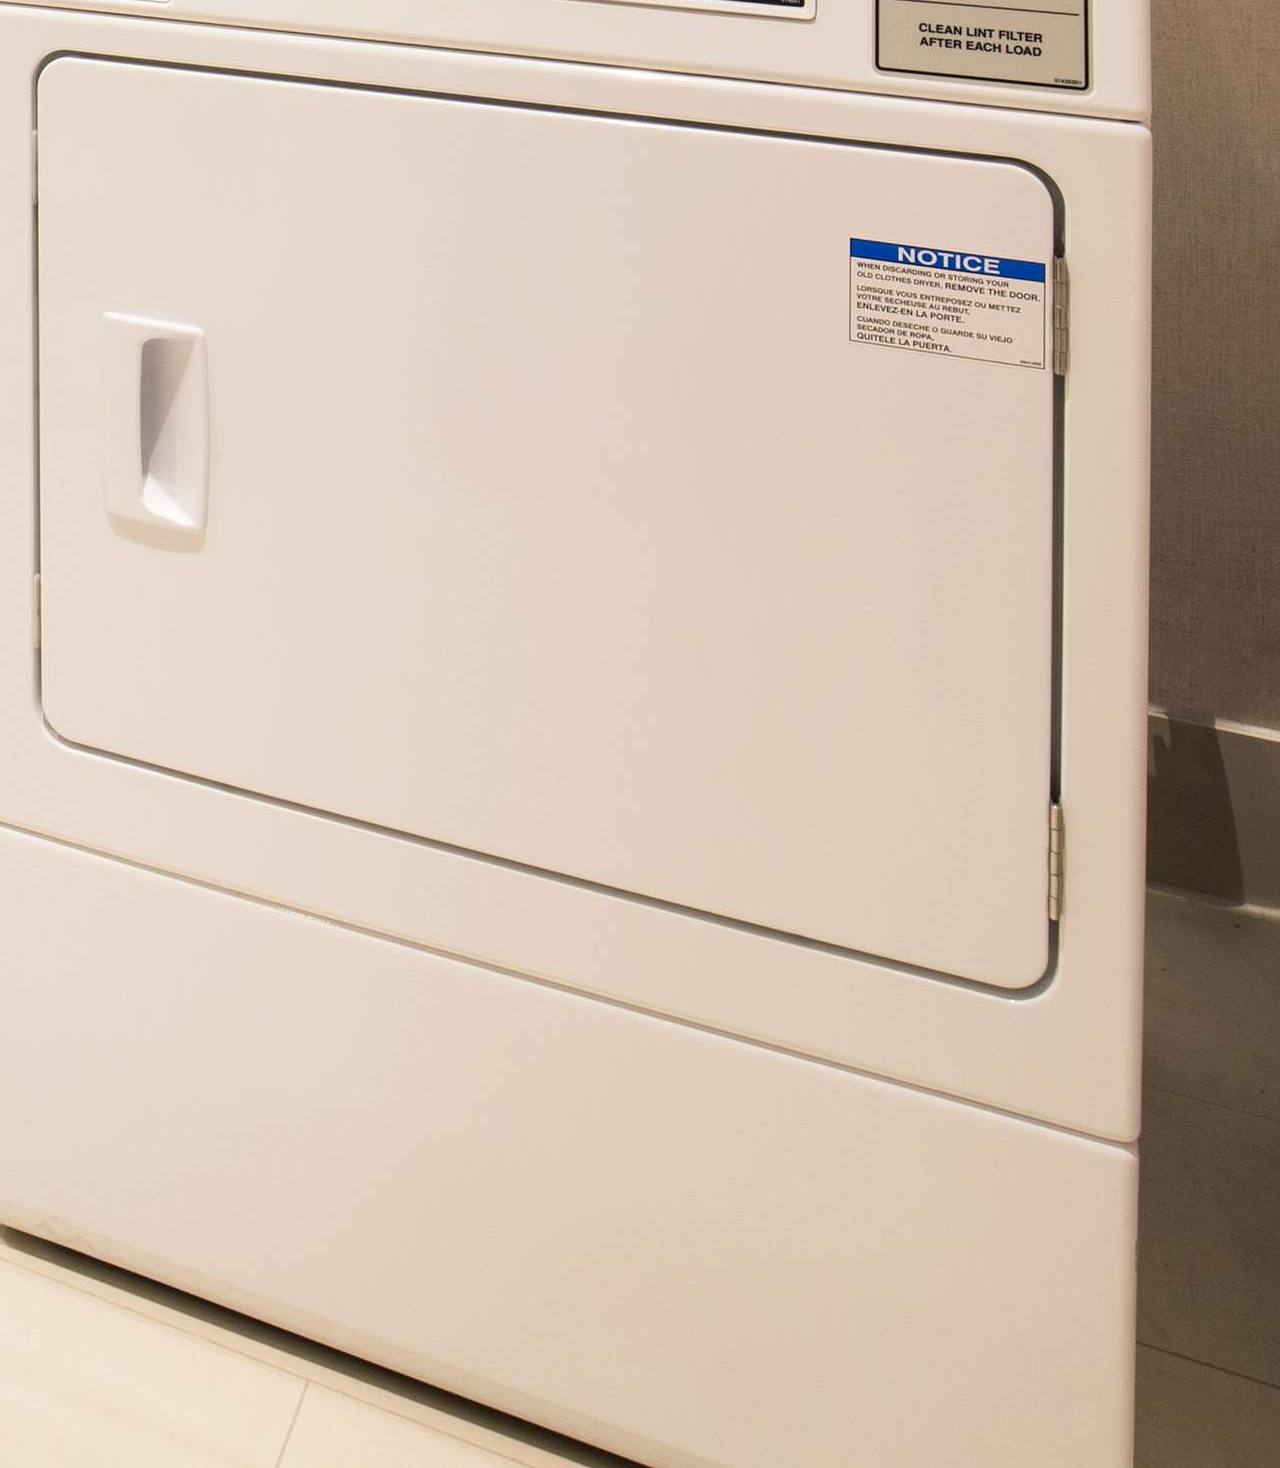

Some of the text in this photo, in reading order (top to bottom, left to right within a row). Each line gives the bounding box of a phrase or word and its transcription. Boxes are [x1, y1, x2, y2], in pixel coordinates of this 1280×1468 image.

[919, 23, 1043, 43] CLEAN LINT FILTER
[920, 38, 1042, 57] AFTER EACH LOAD
[898, 248, 1000, 273] NOTICE
[857, 262, 881, 271] WHEN
[882, 265, 932, 277] DISCARDING
[947, 273, 984, 284] STORING
[985, 278, 1009, 287] YOUR
[874, 274, 911, 284] CLOTHES
[913, 279, 943, 290] DRYER,
[945, 284, 985, 295] REMOVE
[987, 288, 1007, 297] THE
[1009, 291, 1040, 301] DOOR.
[857, 285, 894, 296] LORSQUE
[895, 290, 918, 299] VOUS
[919, 294, 973, 306] ENTREPOSEZ
[988, 303, 1021, 313] METTEZ
[857, 294, 882, 303] VOTRE
[884, 297, 927, 309] SECHEUSE
[941, 305, 970, 316] REBUT,
[857, 302, 965, 323] ENLEVEZ-EN LA PORTE.
[857, 316, 890, 326] CUANDO
[892, 321, 930, 332] DESECHE
[940, 328, 974, 338] GUARDE
[989, 334, 1013, 343] VIEJO
[857, 324, 895, 335] SECADOR
[909, 332, 935, 342] ROPA,
[857, 333, 953, 353] QUITELE LA PUERTA.
